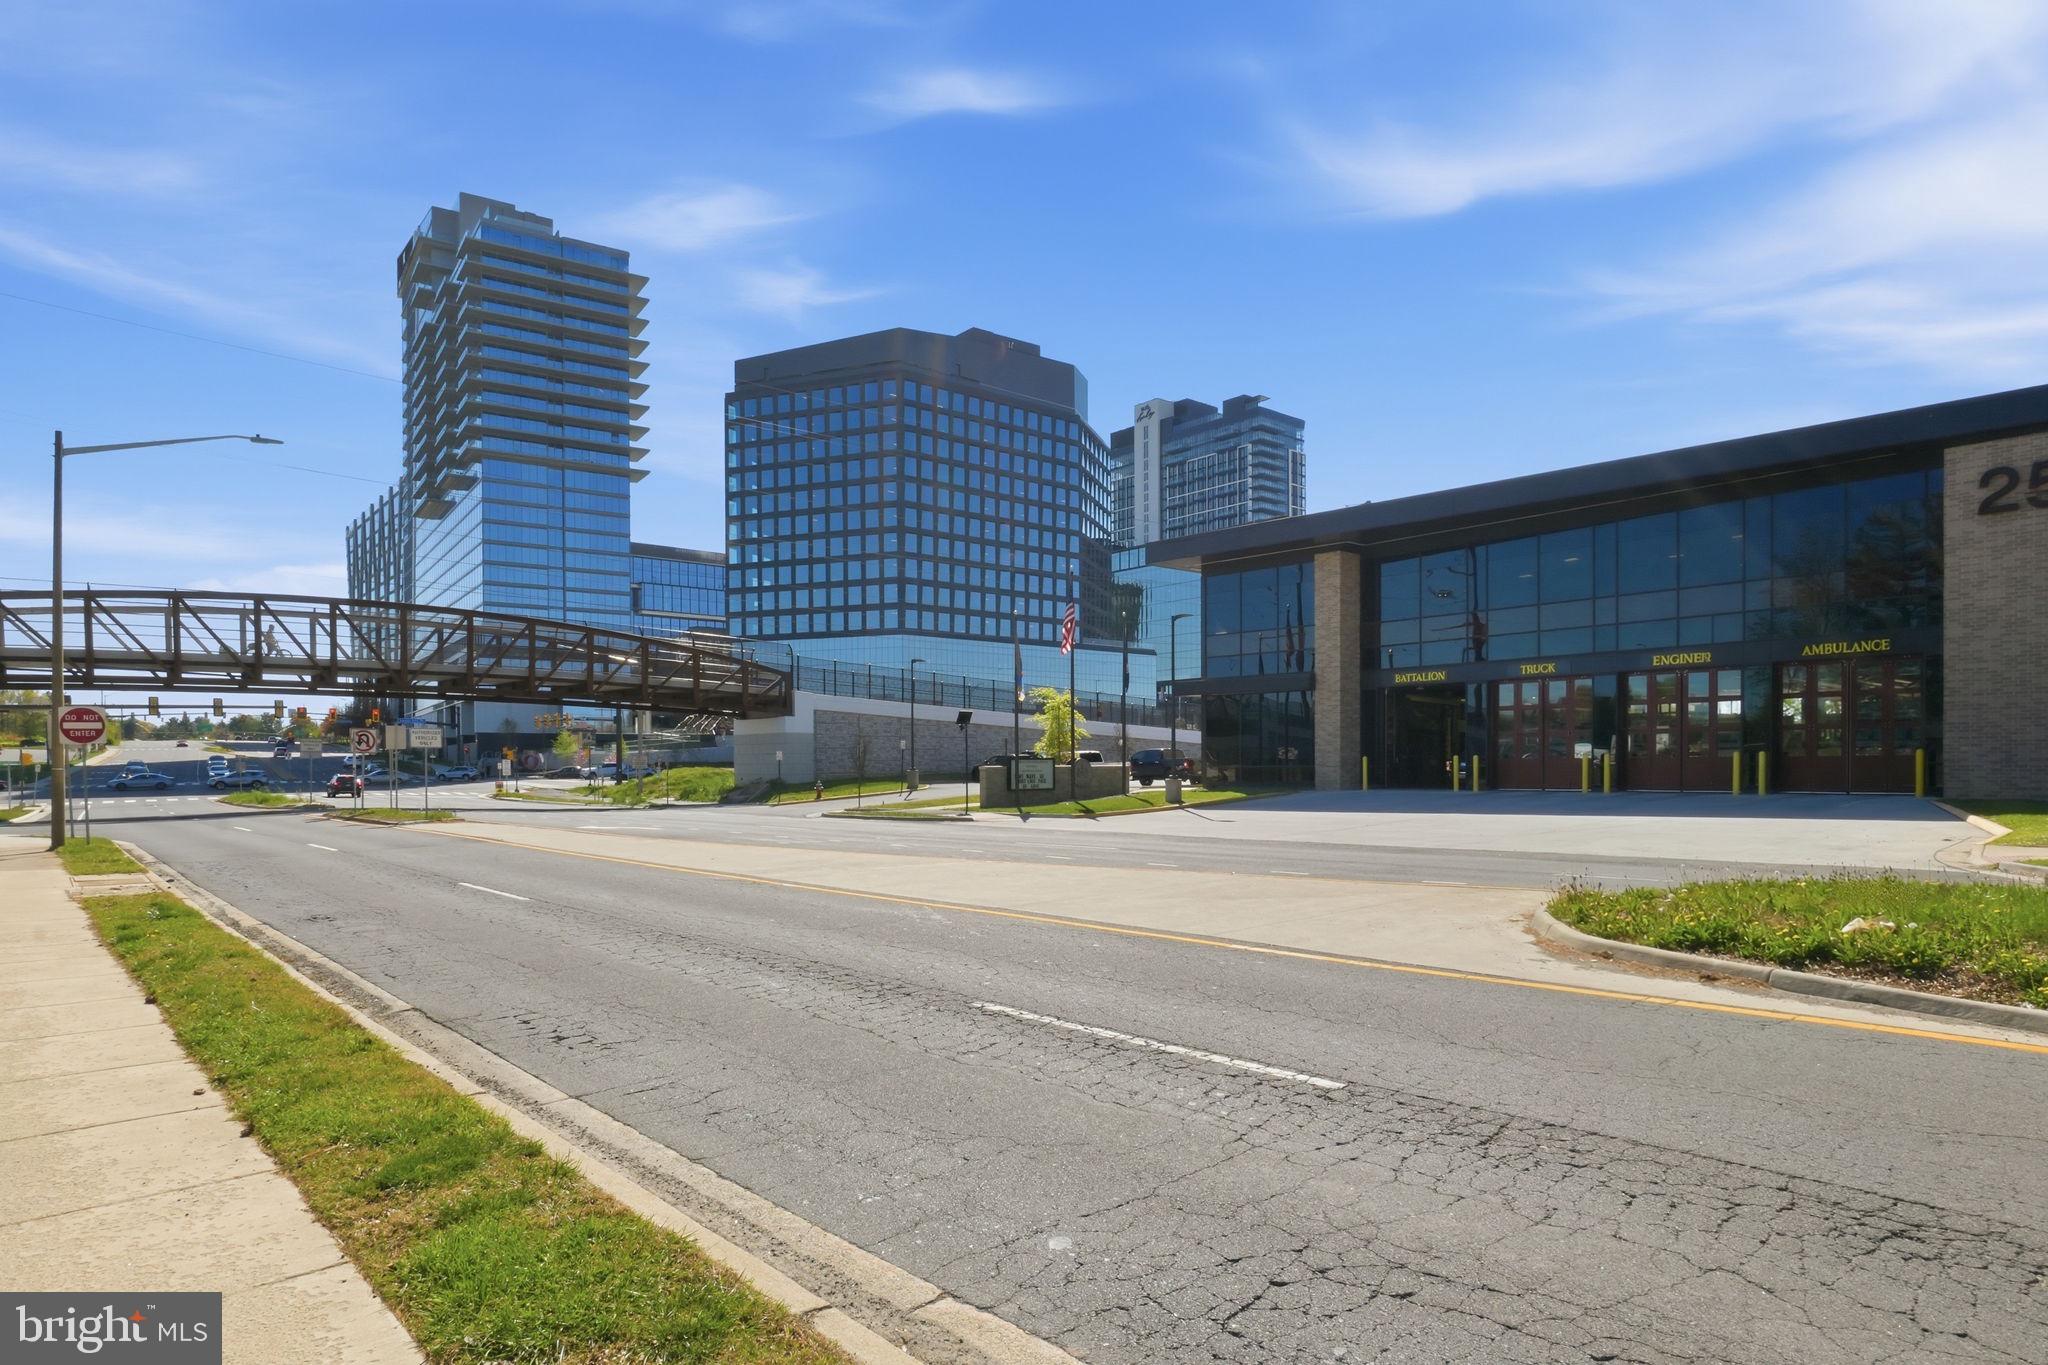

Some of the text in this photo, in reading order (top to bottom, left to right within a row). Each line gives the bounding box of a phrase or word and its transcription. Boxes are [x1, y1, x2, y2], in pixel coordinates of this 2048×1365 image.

[1802, 638, 1890, 656] AMBULANCE
[1520, 662, 1556, 675] TRUCK
[1395, 671, 1446, 683] BATTALION
